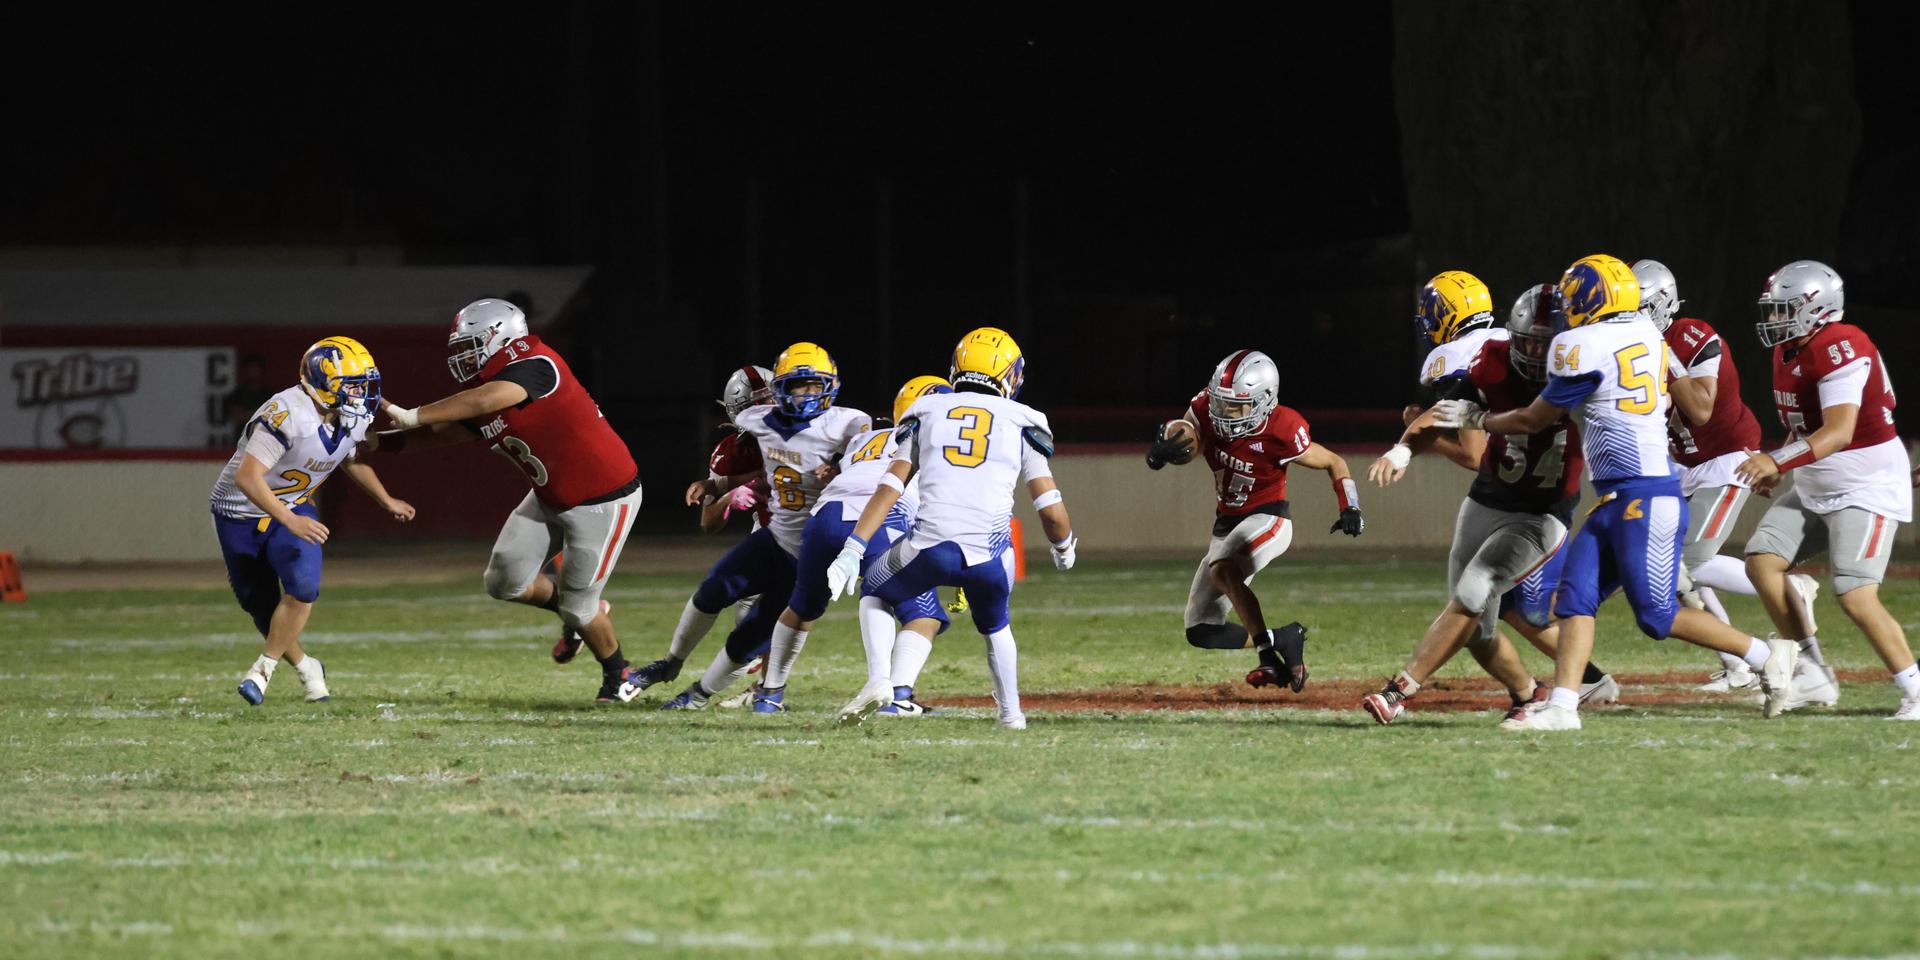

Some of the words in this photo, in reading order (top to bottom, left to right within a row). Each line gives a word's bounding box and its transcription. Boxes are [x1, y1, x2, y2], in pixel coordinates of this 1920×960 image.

[505, 340, 529, 360] 13
[1683, 325, 1705, 348] 11
[1552, 343, 1580, 371] 54
[1827, 339, 1855, 365] 55
[12, 353, 138, 409] Tribe
[261, 401, 290, 430] 24
[479, 414, 508, 440] TRIBE
[942, 405, 994, 469] 3
[1294, 426, 1310, 453] 15
[489, 435, 548, 487] 13
[1213, 449, 1254, 474] TRIBE
[1497, 429, 1568, 488] 54
[773, 465, 806, 512] 6
[1213, 470, 1255, 507] 15
